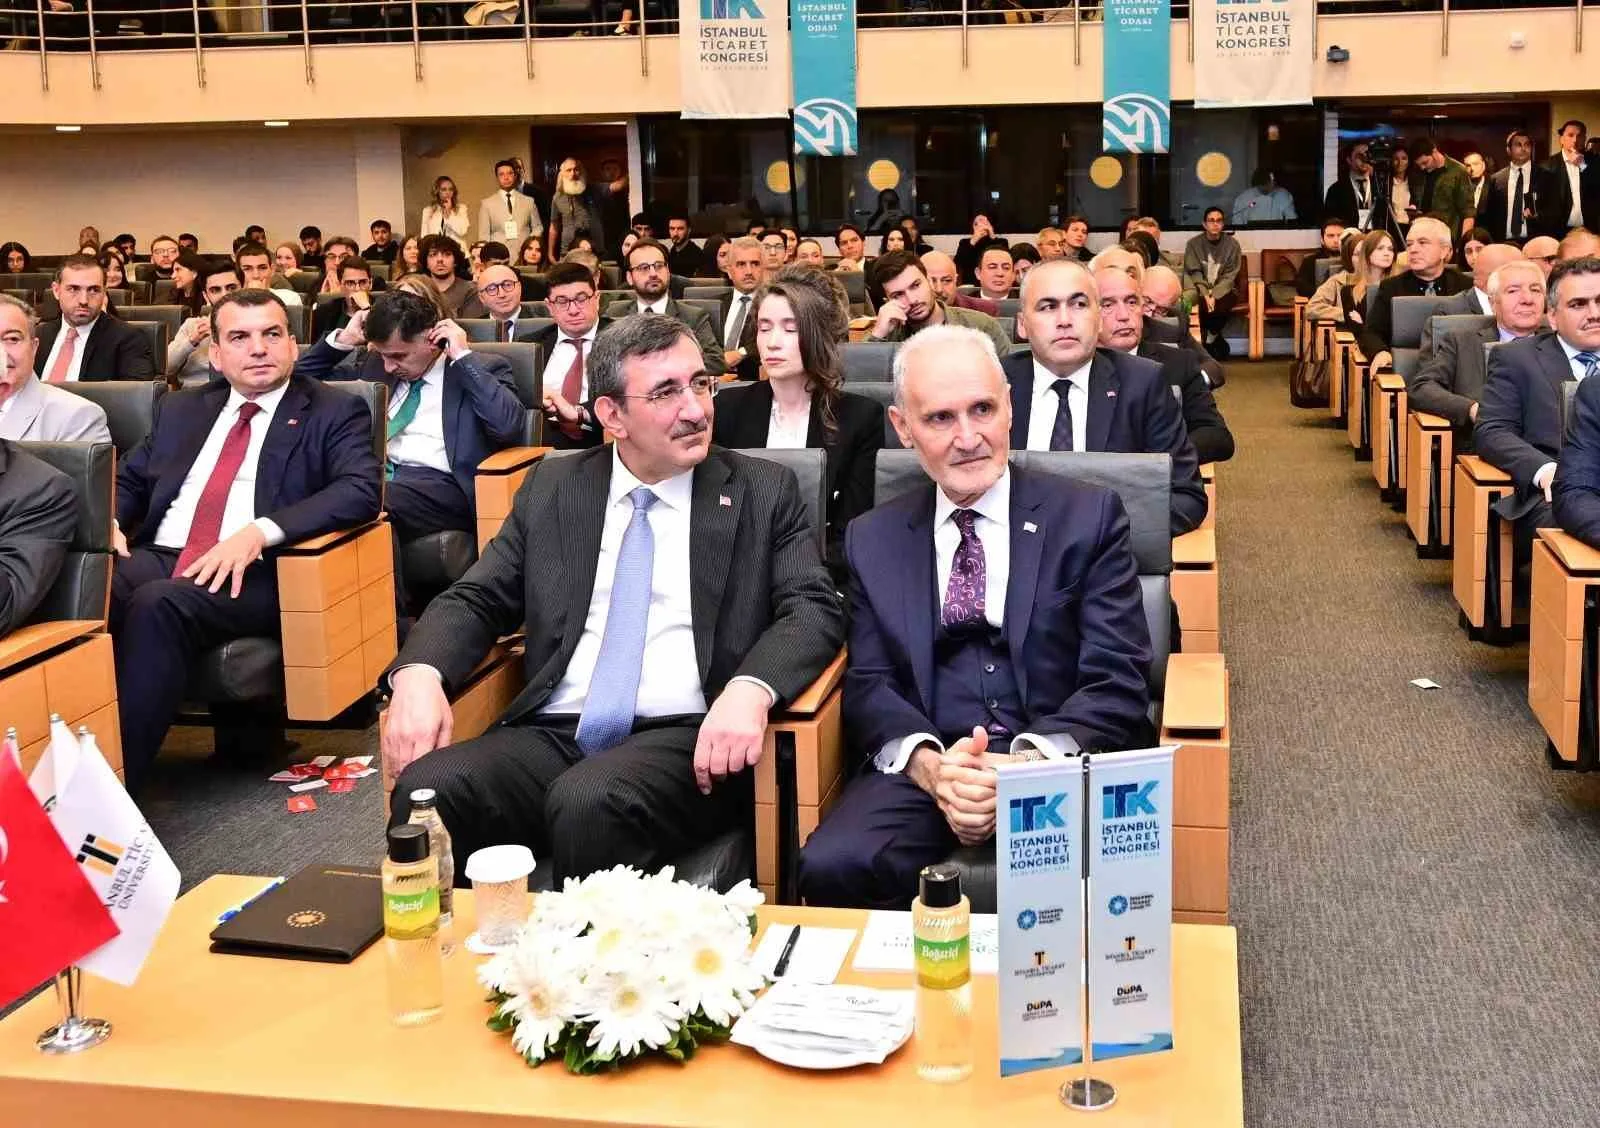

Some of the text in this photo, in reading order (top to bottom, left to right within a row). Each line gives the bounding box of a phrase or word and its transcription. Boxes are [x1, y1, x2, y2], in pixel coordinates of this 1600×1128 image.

[1113, 5, 1160, 15] TİCARET
[1216, 10, 1290, 24] İSTANBUL
[801, 13, 844, 22] TİCARET
[700, 24, 768, 38] İSTANBUL
[1216, 24, 1291, 36] TİCARET
[700, 38, 768, 50] TİCARET
[1216, 35, 1290, 49] KONGRESİ
[700, 51, 768, 63] KONGRESİ
[1102, 820, 1160, 835] İSTANBUL
[1010, 834, 1069, 849] İSTANBUL
[1102, 831, 1160, 845] TİCARET
[1011, 844, 1069, 860] TİCARET
[1102, 840, 1160, 856] KONGRESİ
[1010, 852, 1070, 870] KONGRESİ
